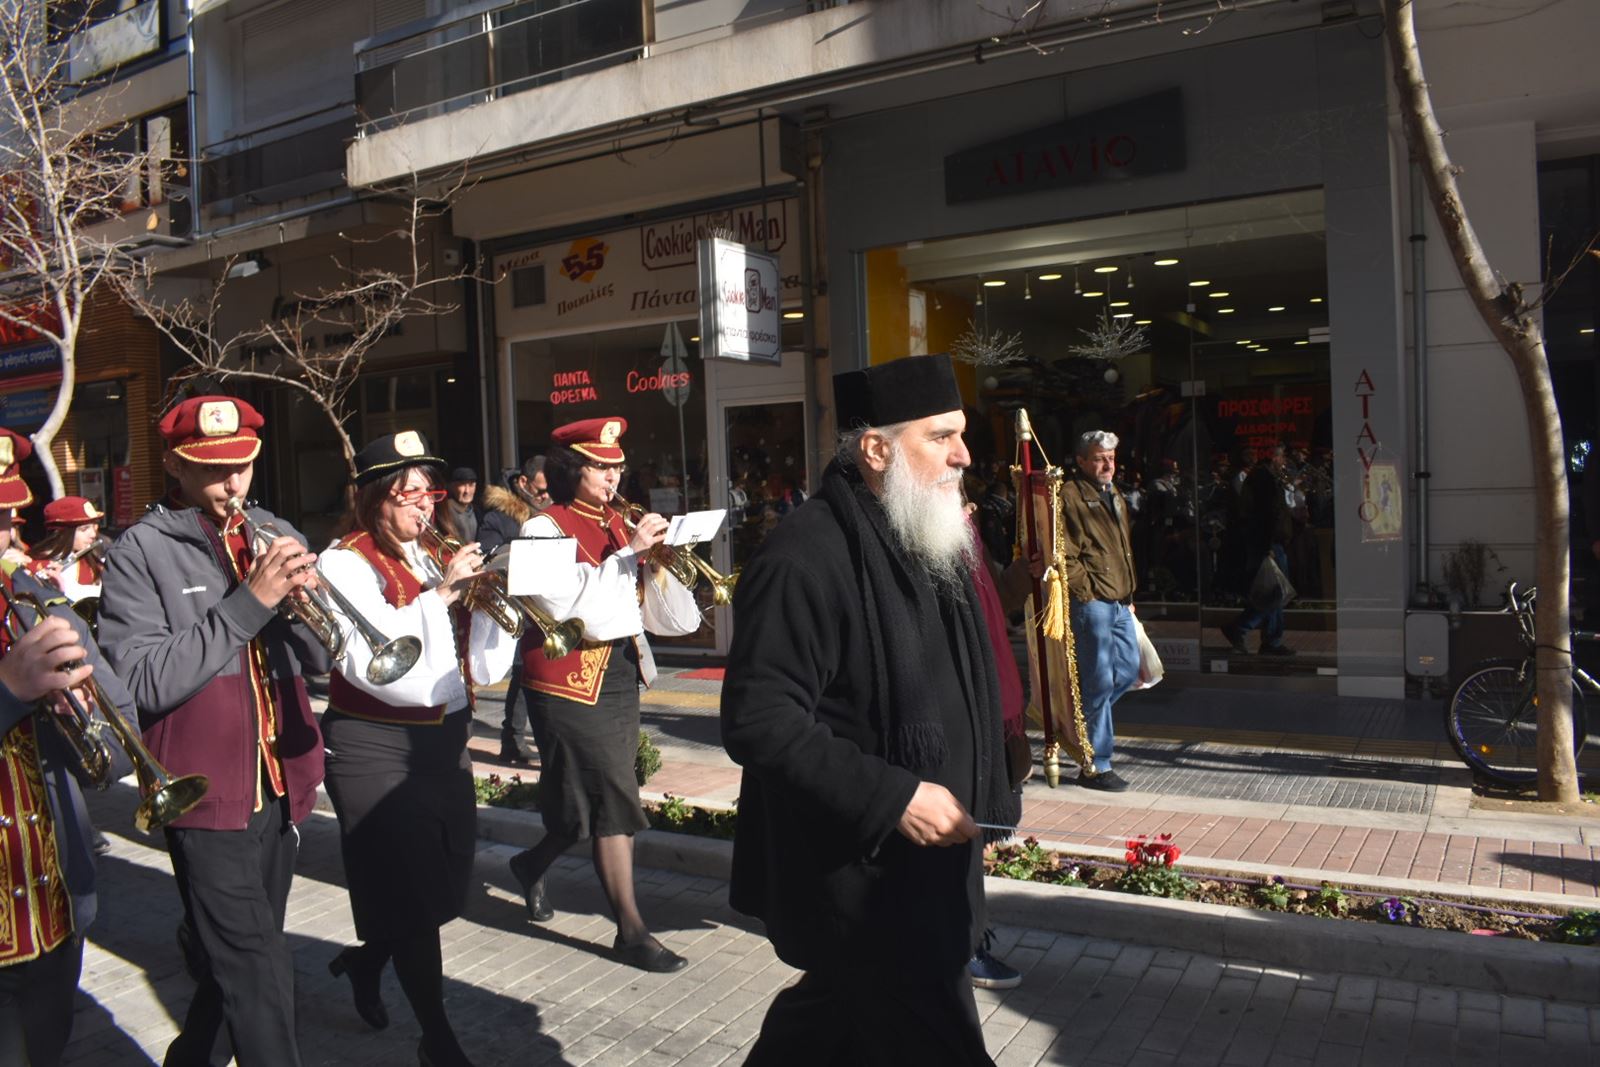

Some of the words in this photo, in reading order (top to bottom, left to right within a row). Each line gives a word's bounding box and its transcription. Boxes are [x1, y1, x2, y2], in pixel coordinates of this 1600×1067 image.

[646, 222, 693, 261] Cookie
[738, 209, 781, 243] Man
[561, 241, 606, 282] 55
[630, 287, 697, 311] Πάντα
[760, 287, 777, 313] Man
[553, 369, 592, 388] ΠΑΝΤΑ
[626, 367, 691, 394] Cookies
[550, 386, 598, 405] ΦΡΕΣΚΑ
[1217, 396, 1313, 418] ΠΡΟΣΦΟΡΕΣ
